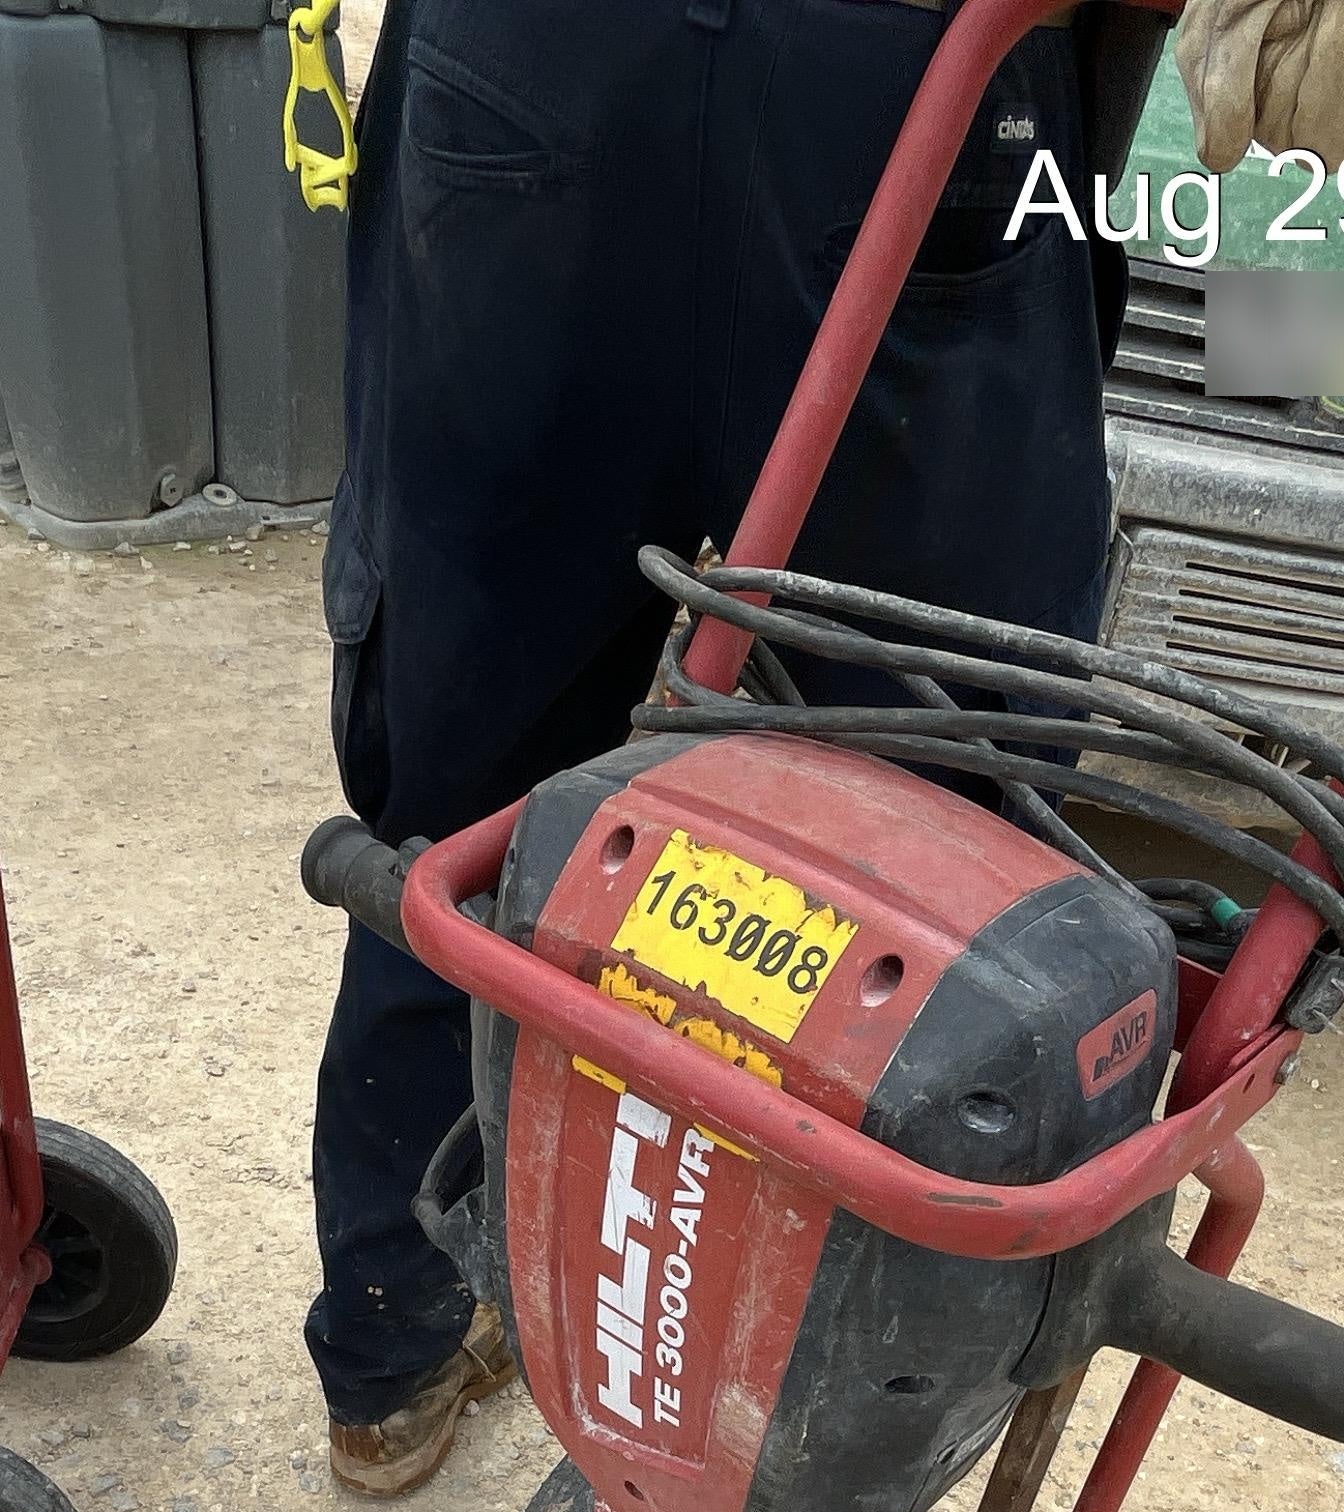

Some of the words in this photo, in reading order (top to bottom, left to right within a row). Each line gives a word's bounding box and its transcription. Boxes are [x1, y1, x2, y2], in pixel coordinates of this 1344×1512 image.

[646, 870, 829, 995] 163008
[1109, 1010, 1147, 1060] AVR
[595, 1091, 672, 1429] HILTI
[654, 1127, 716, 1378] 3000-AVR
[654, 1376, 682, 1428] TE
